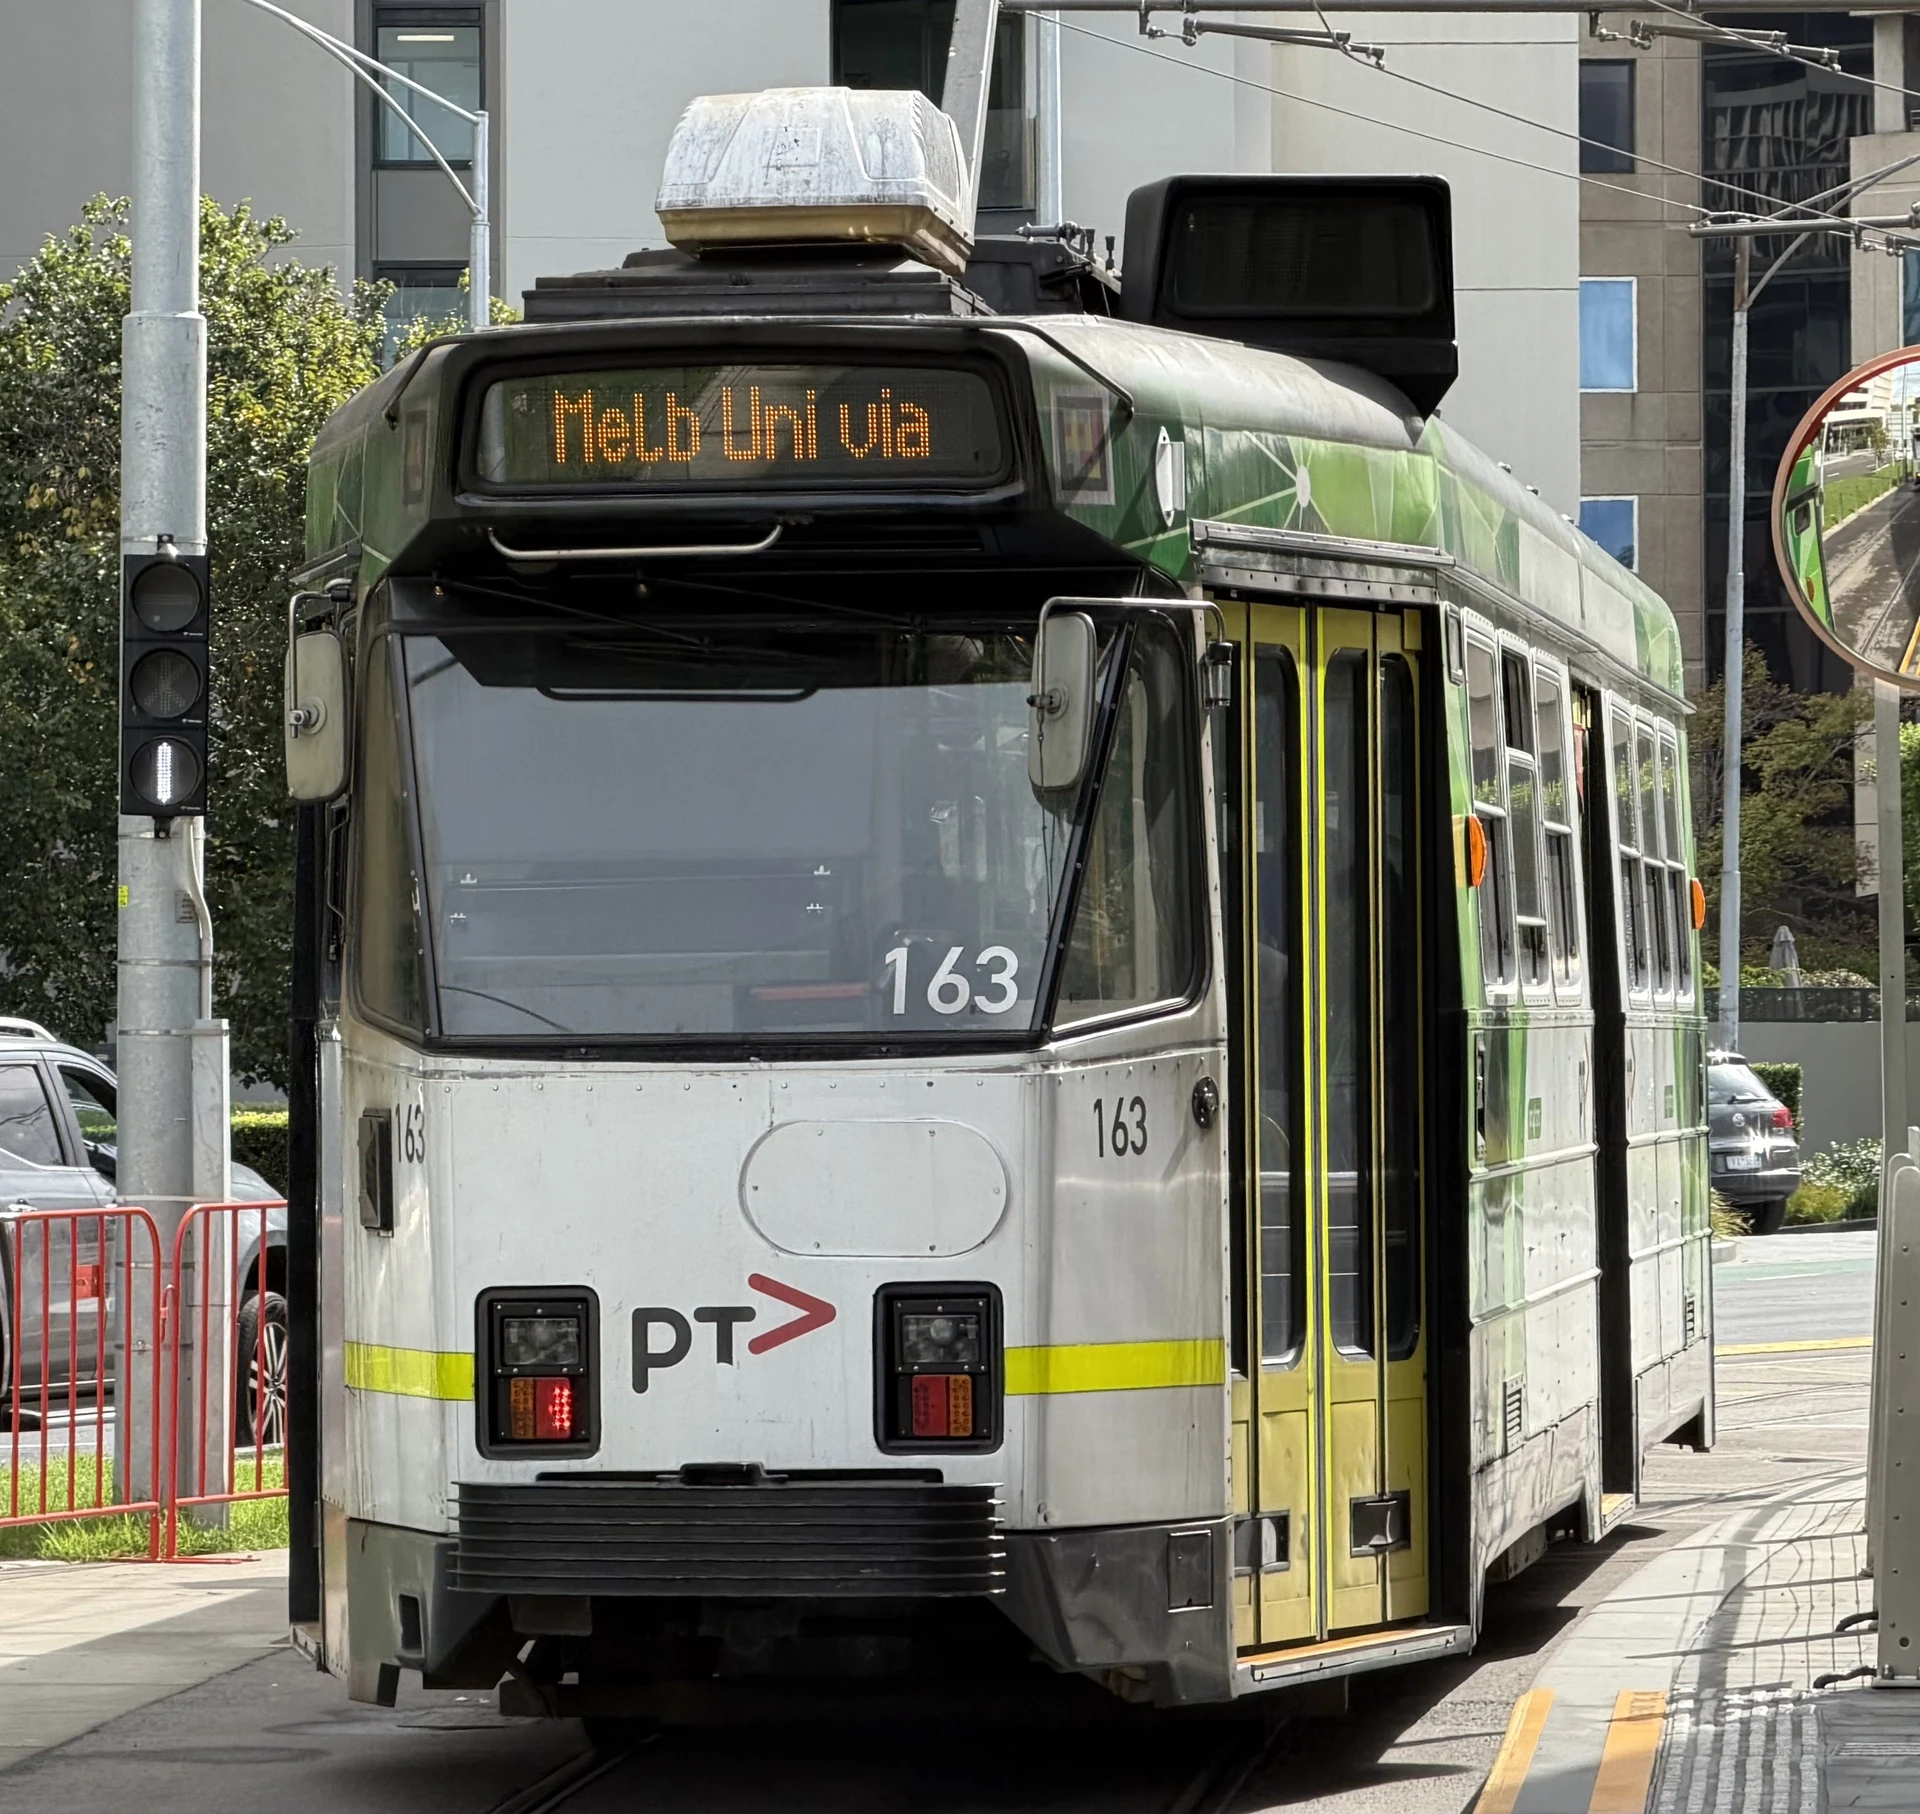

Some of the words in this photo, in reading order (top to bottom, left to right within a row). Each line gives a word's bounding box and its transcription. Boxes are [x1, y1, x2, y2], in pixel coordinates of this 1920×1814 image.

[554, 388, 701, 464] Melb
[722, 385, 818, 461] Uni
[839, 387, 931, 460] via
[885, 945, 1020, 1015] 163
[395, 1103, 426, 1164] 163
[1093, 1095, 1148, 1158] 163
